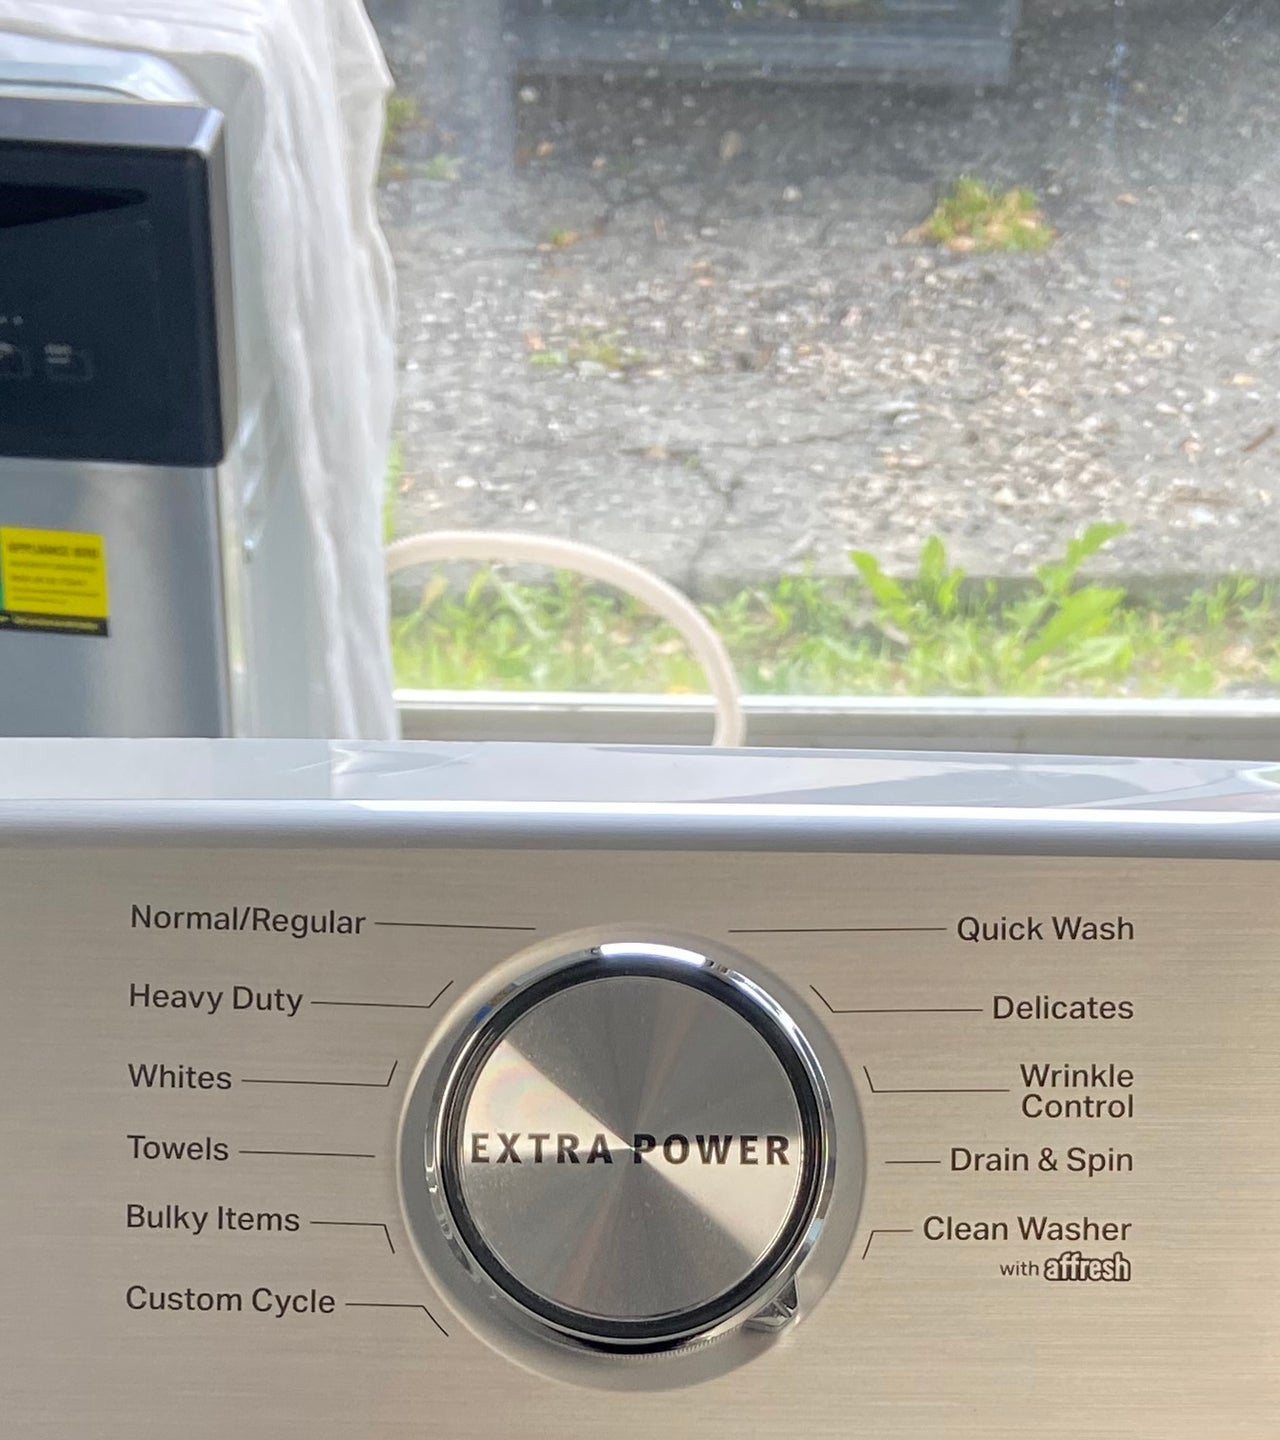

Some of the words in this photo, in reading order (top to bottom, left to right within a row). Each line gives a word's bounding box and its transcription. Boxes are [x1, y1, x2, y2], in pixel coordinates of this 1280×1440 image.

[130, 904, 367, 939] Normal/Regular
[956, 915, 1044, 943] Quick
[1051, 915, 1135, 941] Wash
[128, 983, 223, 1014] Heavy
[232, 985, 303, 1017] Duty
[992, 995, 1135, 1020] Delicates
[127, 1063, 233, 1091] Whites
[1019, 1063, 1135, 1088] Wrinkle
[1021, 1093, 1134, 1119] Control
[126, 1134, 230, 1161] Towels
[470, 1132, 614, 1165] EXTRA
[632, 1133, 791, 1166] POWER
[950, 1146, 1029, 1172] Drain
[1037, 1147, 1058, 1172] &
[1066, 1147, 1134, 1177] Spin
[125, 1203, 209, 1236] Bulky
[217, 1206, 301, 1232] Items
[922, 1216, 1009, 1241] Clean
[1017, 1216, 1133, 1241] Washer
[999, 1261, 1040, 1277] with
[1043, 1250, 1132, 1282] affresh
[125, 1284, 243, 1312] Custom
[251, 1287, 337, 1318] Cycle
